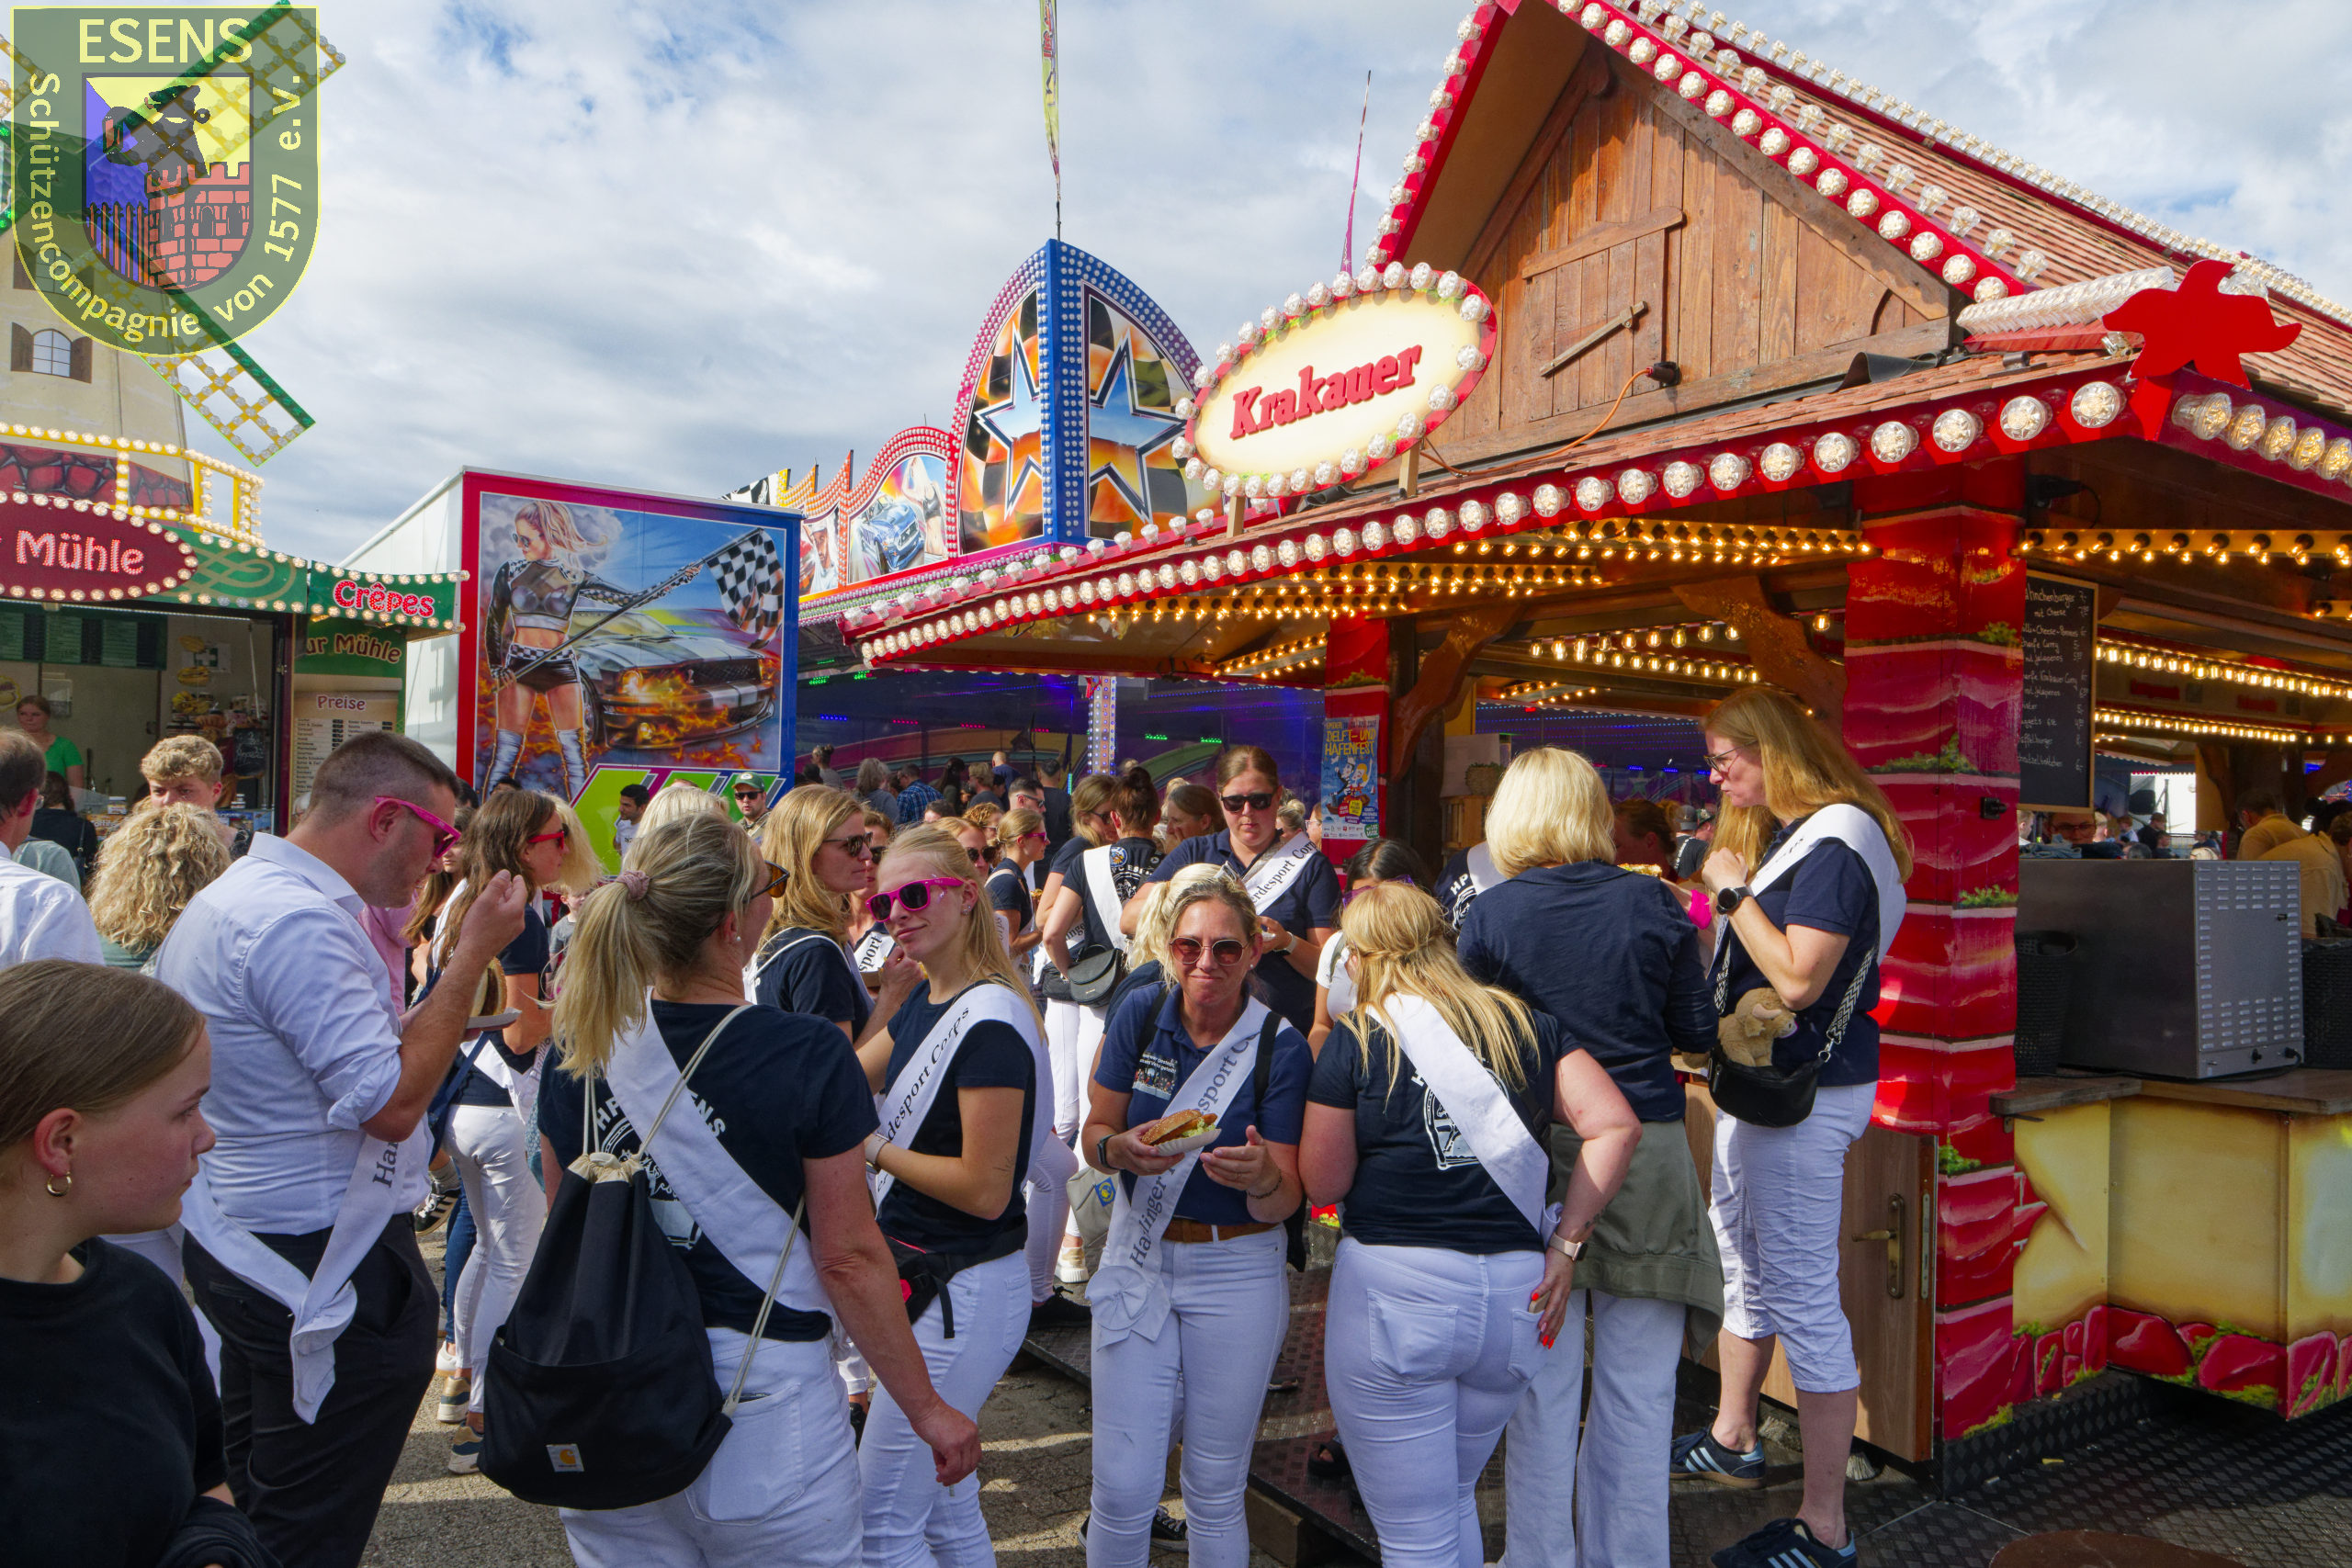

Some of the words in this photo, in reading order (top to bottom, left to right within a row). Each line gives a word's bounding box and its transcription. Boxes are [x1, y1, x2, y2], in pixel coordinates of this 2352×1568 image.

[1229, 344, 1422, 440] Krakauer
[16, 530, 145, 576] Mühle
[334, 580, 435, 618] Crêpes
[306, 636, 328, 655] ur
[334, 633, 402, 664] Mühle
[317, 695, 367, 711] Preise
[1325, 740, 1375, 758] HAFENFEST
[931, 1006, 970, 1066] Corps
